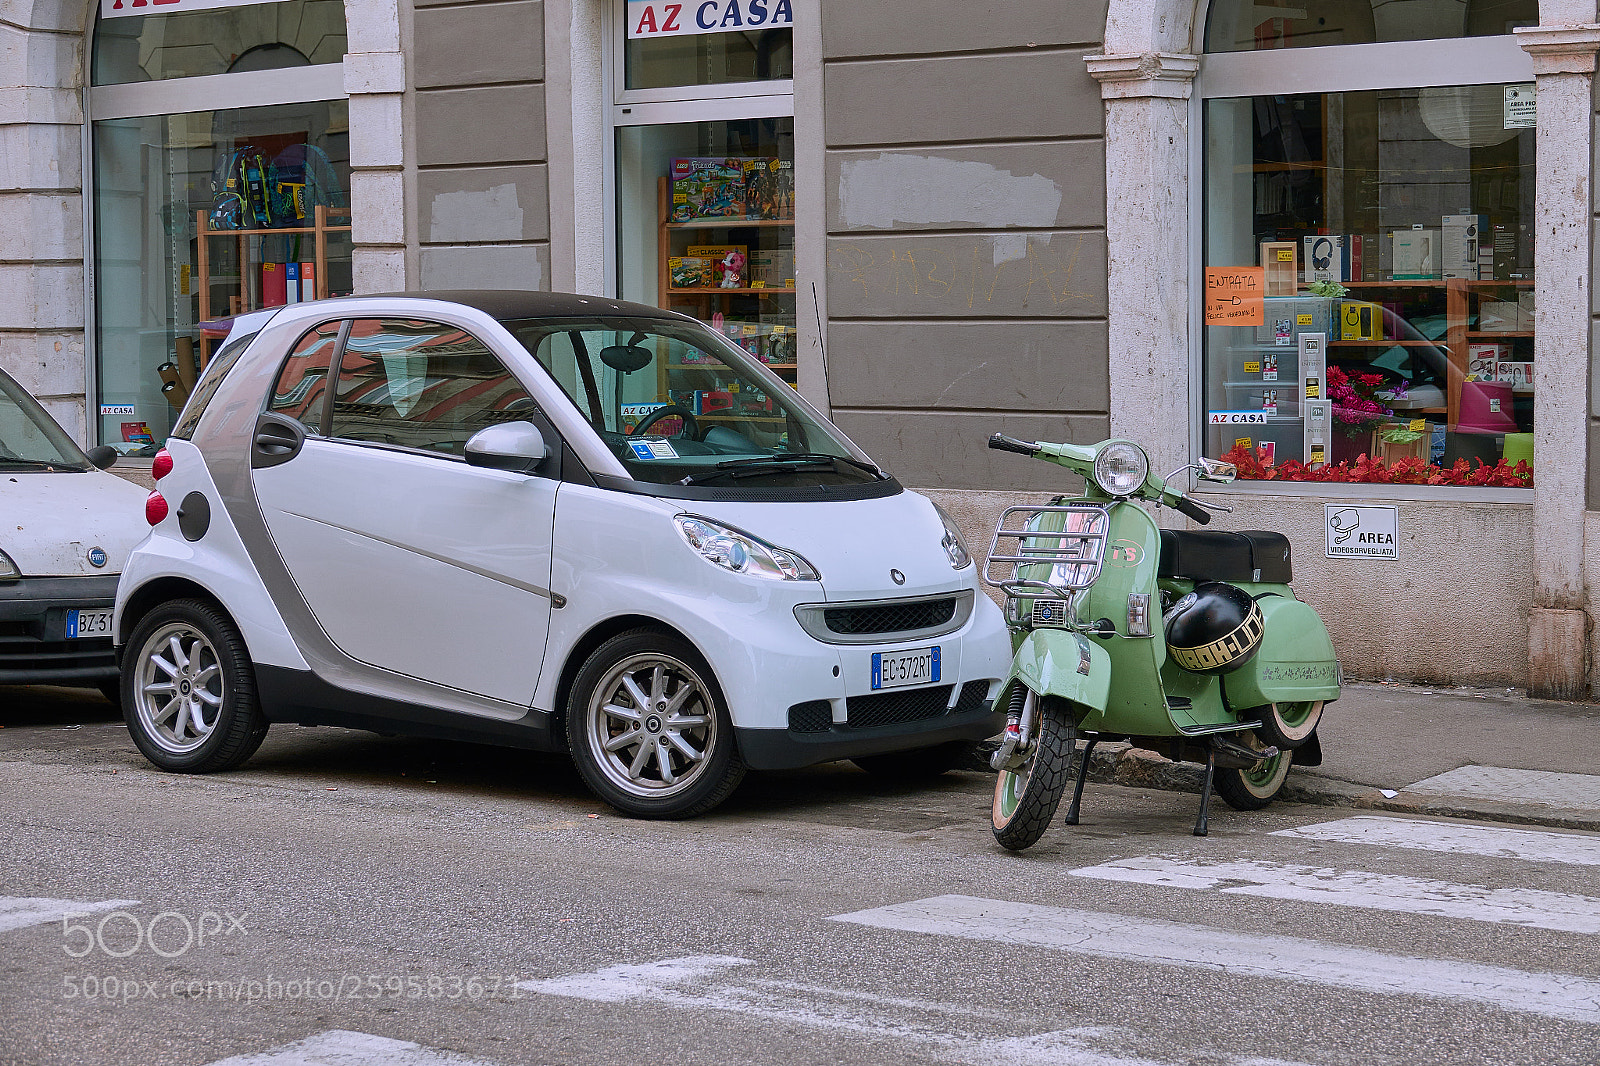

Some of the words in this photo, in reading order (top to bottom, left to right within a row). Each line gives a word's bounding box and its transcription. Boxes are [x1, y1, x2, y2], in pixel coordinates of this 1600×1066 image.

[636, 4, 682, 33] AZ
[696, 0, 793, 29] CASA
[691, 161, 715, 170] Friends
[1208, 274, 1256, 290] ENTRATA
[639, 406, 660, 414] CAS
[1211, 414, 1228, 423] AZ
[1231, 414, 1264, 423] CASA
[1359, 532, 1393, 544] AREA
[1330, 546, 1394, 555] VIDEOSORVEGLIATA
